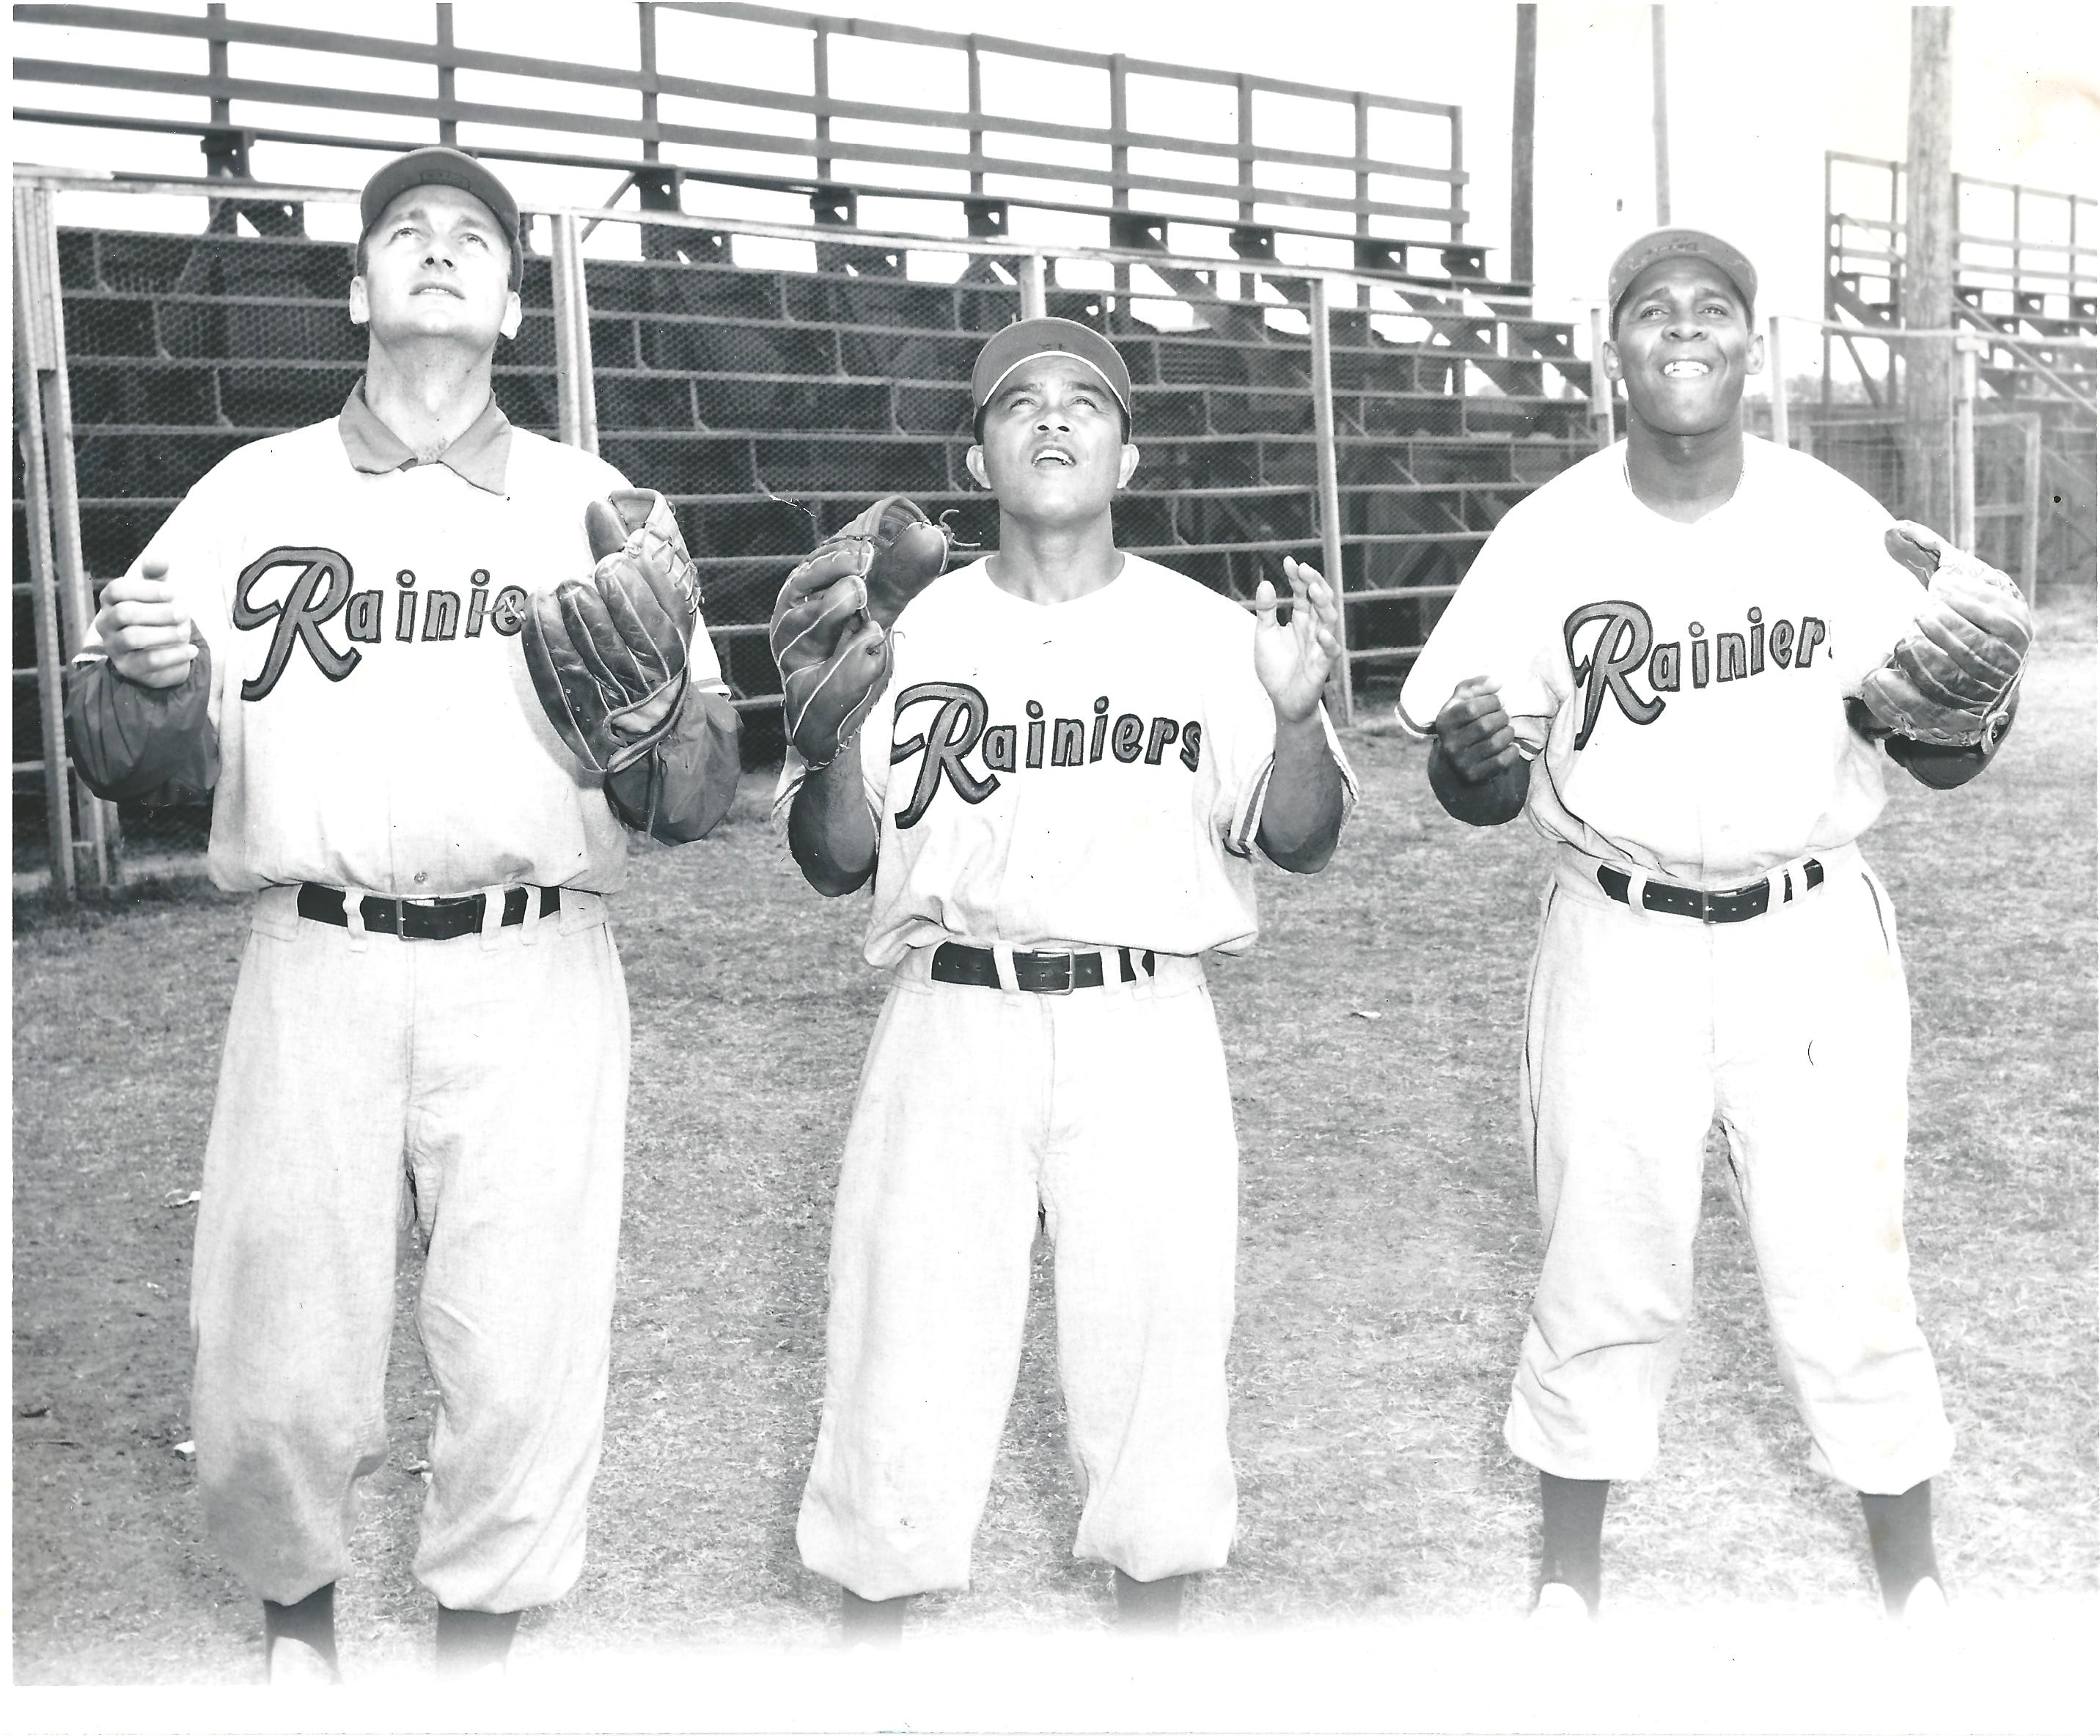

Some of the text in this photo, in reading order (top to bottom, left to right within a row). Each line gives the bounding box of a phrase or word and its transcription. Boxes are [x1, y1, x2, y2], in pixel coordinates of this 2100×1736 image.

[232, 545, 528, 702] Rainie
[1563, 600, 1832, 751] Rainier
[889, 681, 1201, 829] Rainiers
